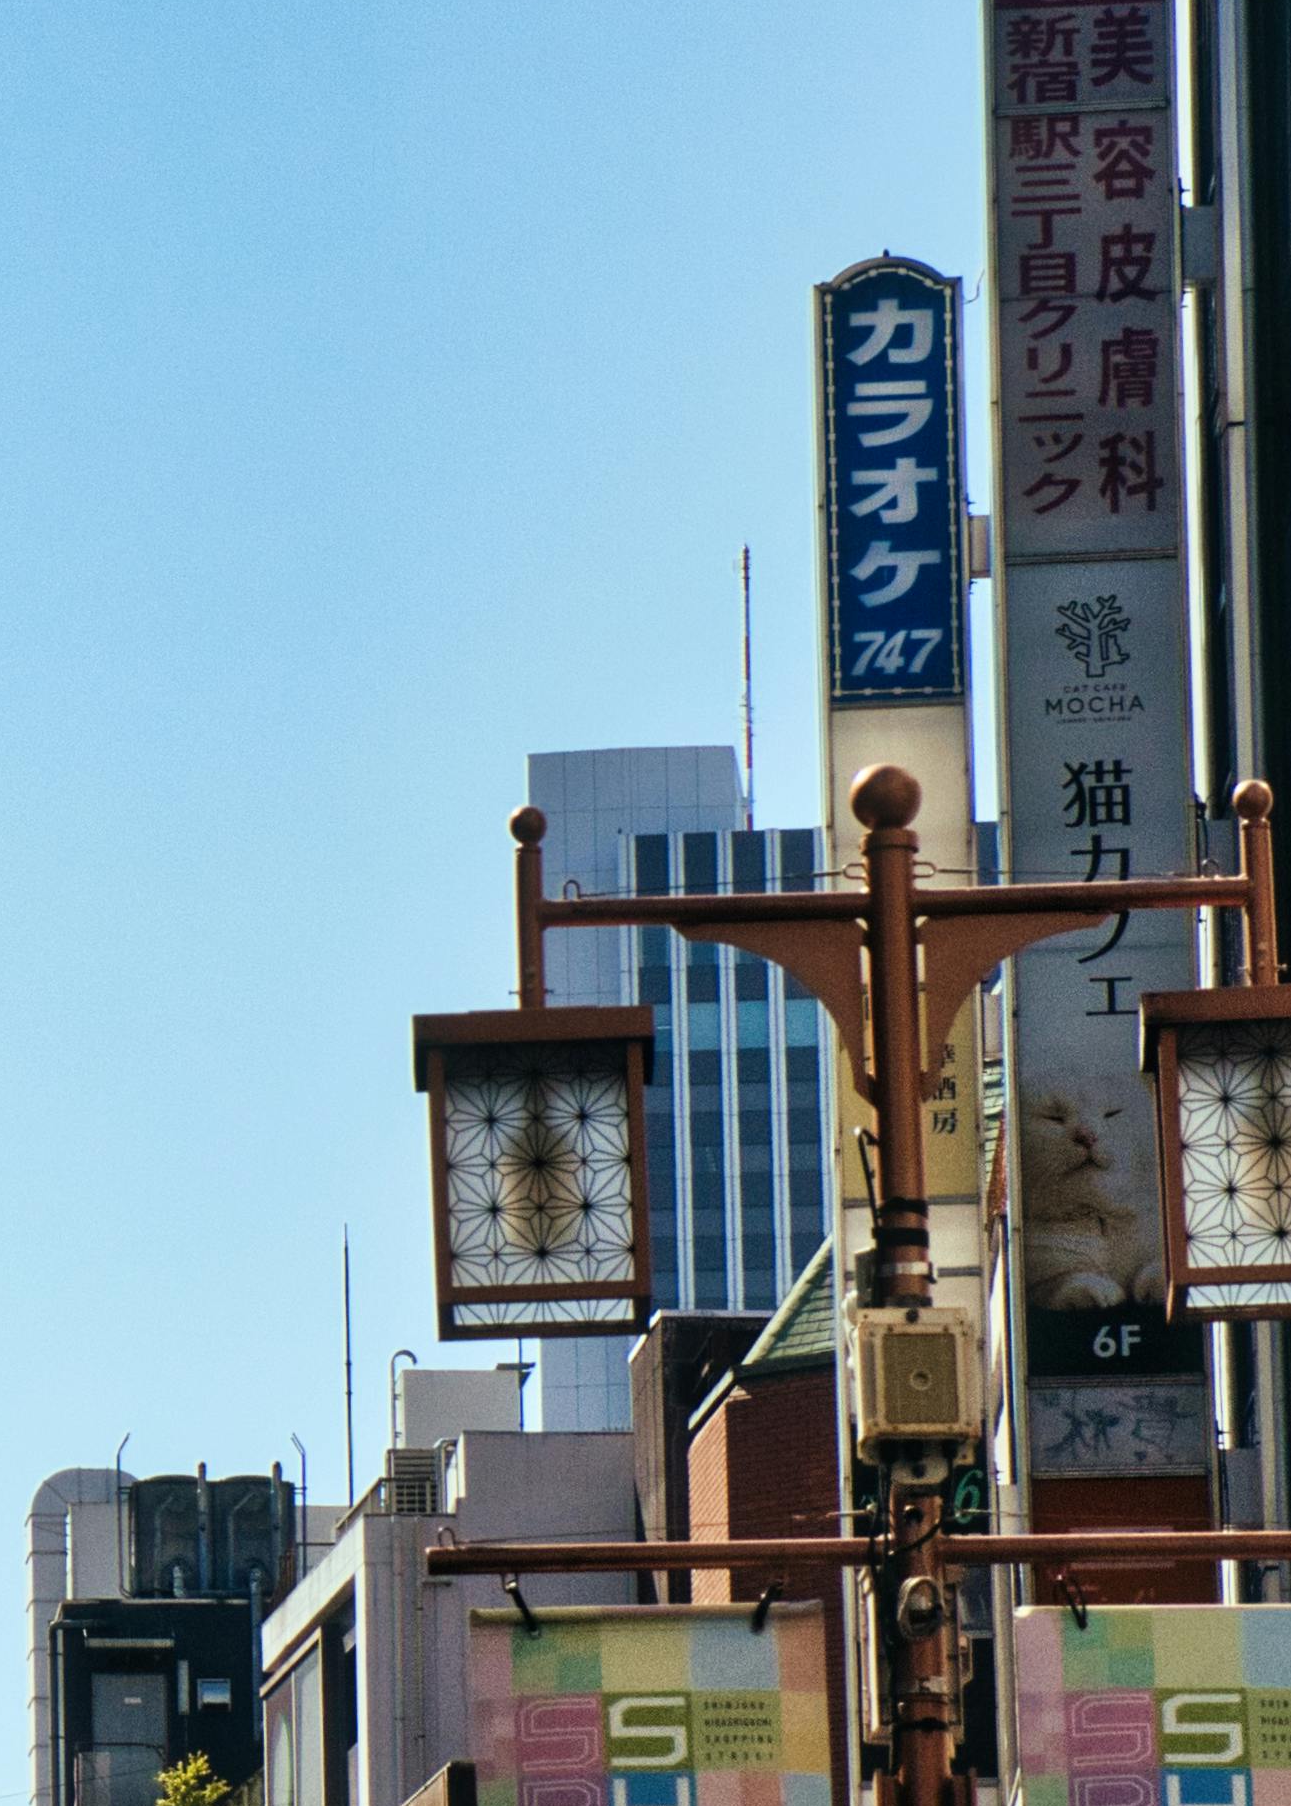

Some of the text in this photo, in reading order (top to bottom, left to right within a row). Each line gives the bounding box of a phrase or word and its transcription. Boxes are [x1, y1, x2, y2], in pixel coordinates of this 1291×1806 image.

[1005, 13, 1083, 515] 新宿駅三丁目クリニック
[1090, 9, 1162, 514] 美容皮膚科
[846, 298, 942, 608] カラオケ
[851, 628, 943, 676] 747
[1046, 695, 1145, 715] MOCHA
[1092, 1325, 1141, 1358] 6F
